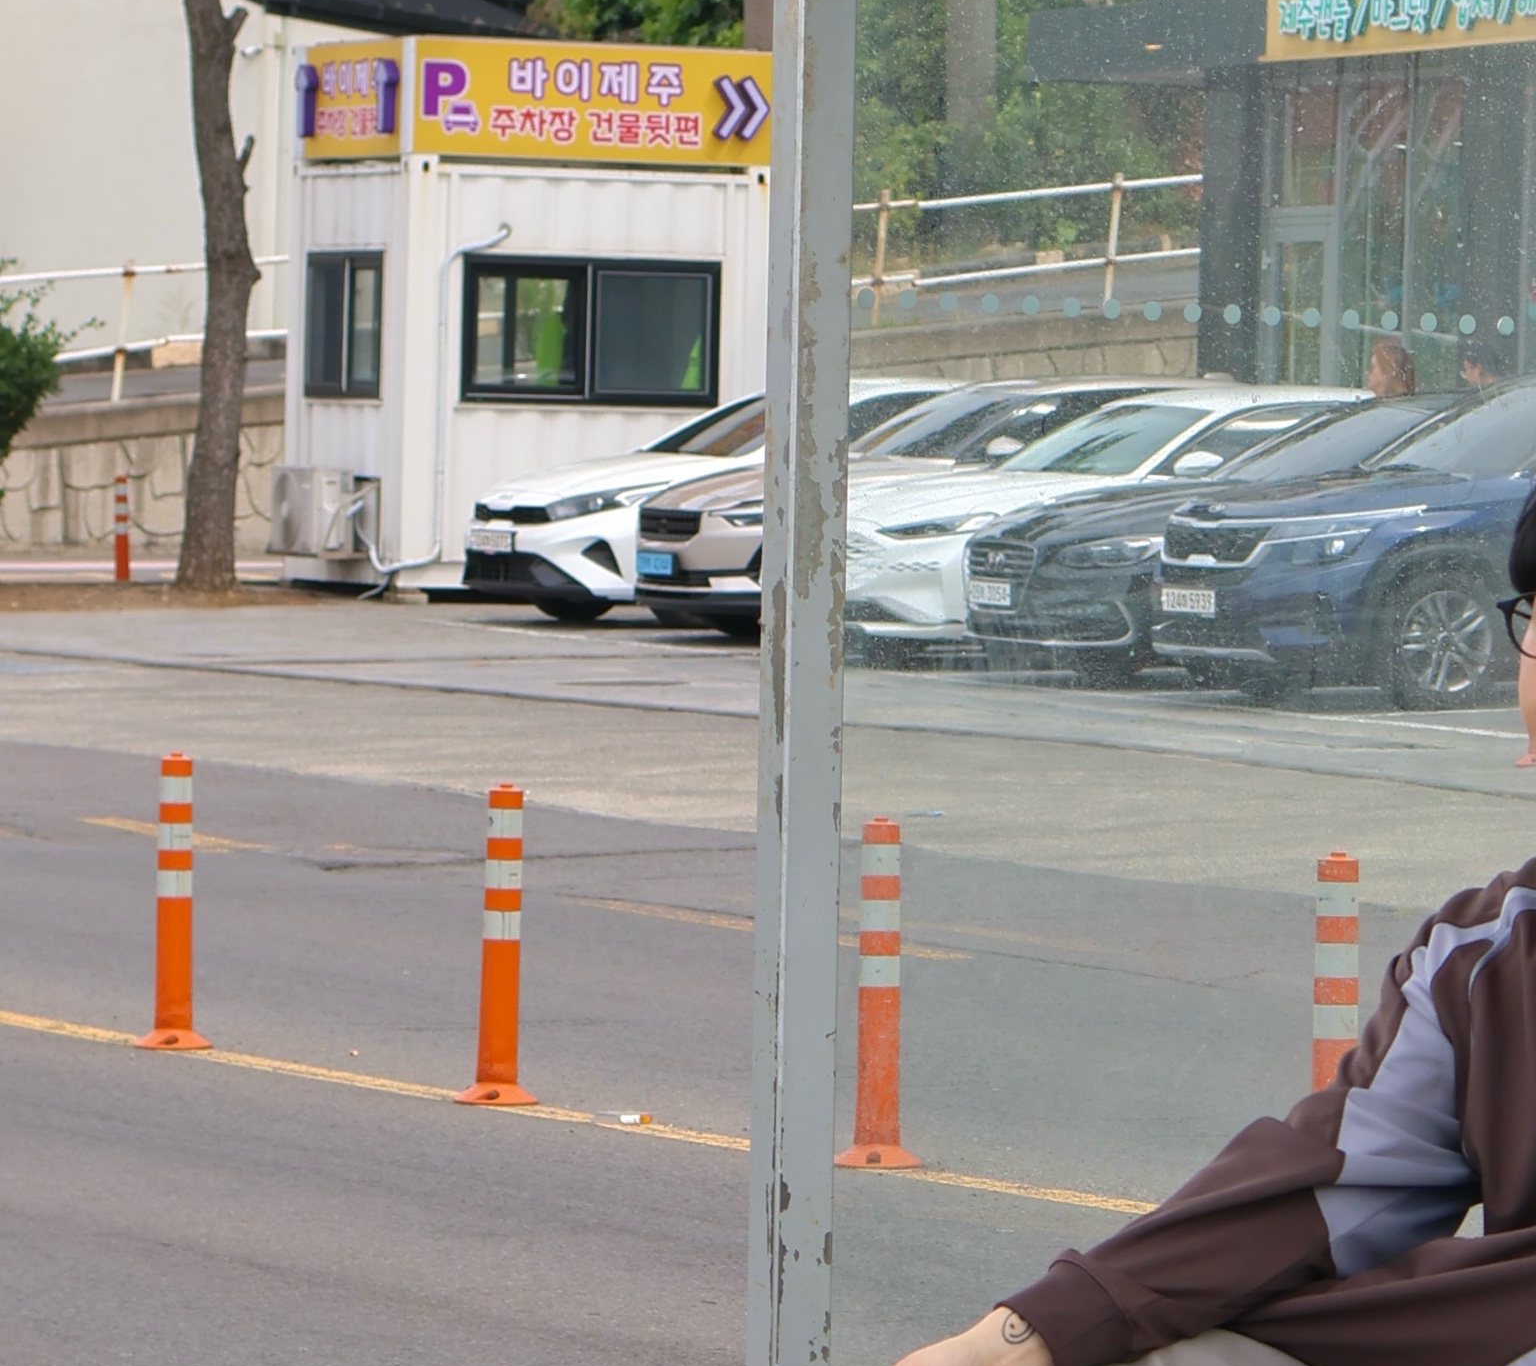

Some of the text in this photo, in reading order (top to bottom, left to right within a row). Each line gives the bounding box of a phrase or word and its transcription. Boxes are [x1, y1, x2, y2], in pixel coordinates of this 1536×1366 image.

[422, 60, 467, 117] P
[508, 57, 684, 107] 바이제주
[490, 105, 702, 148] 주차장 건물뒷편
